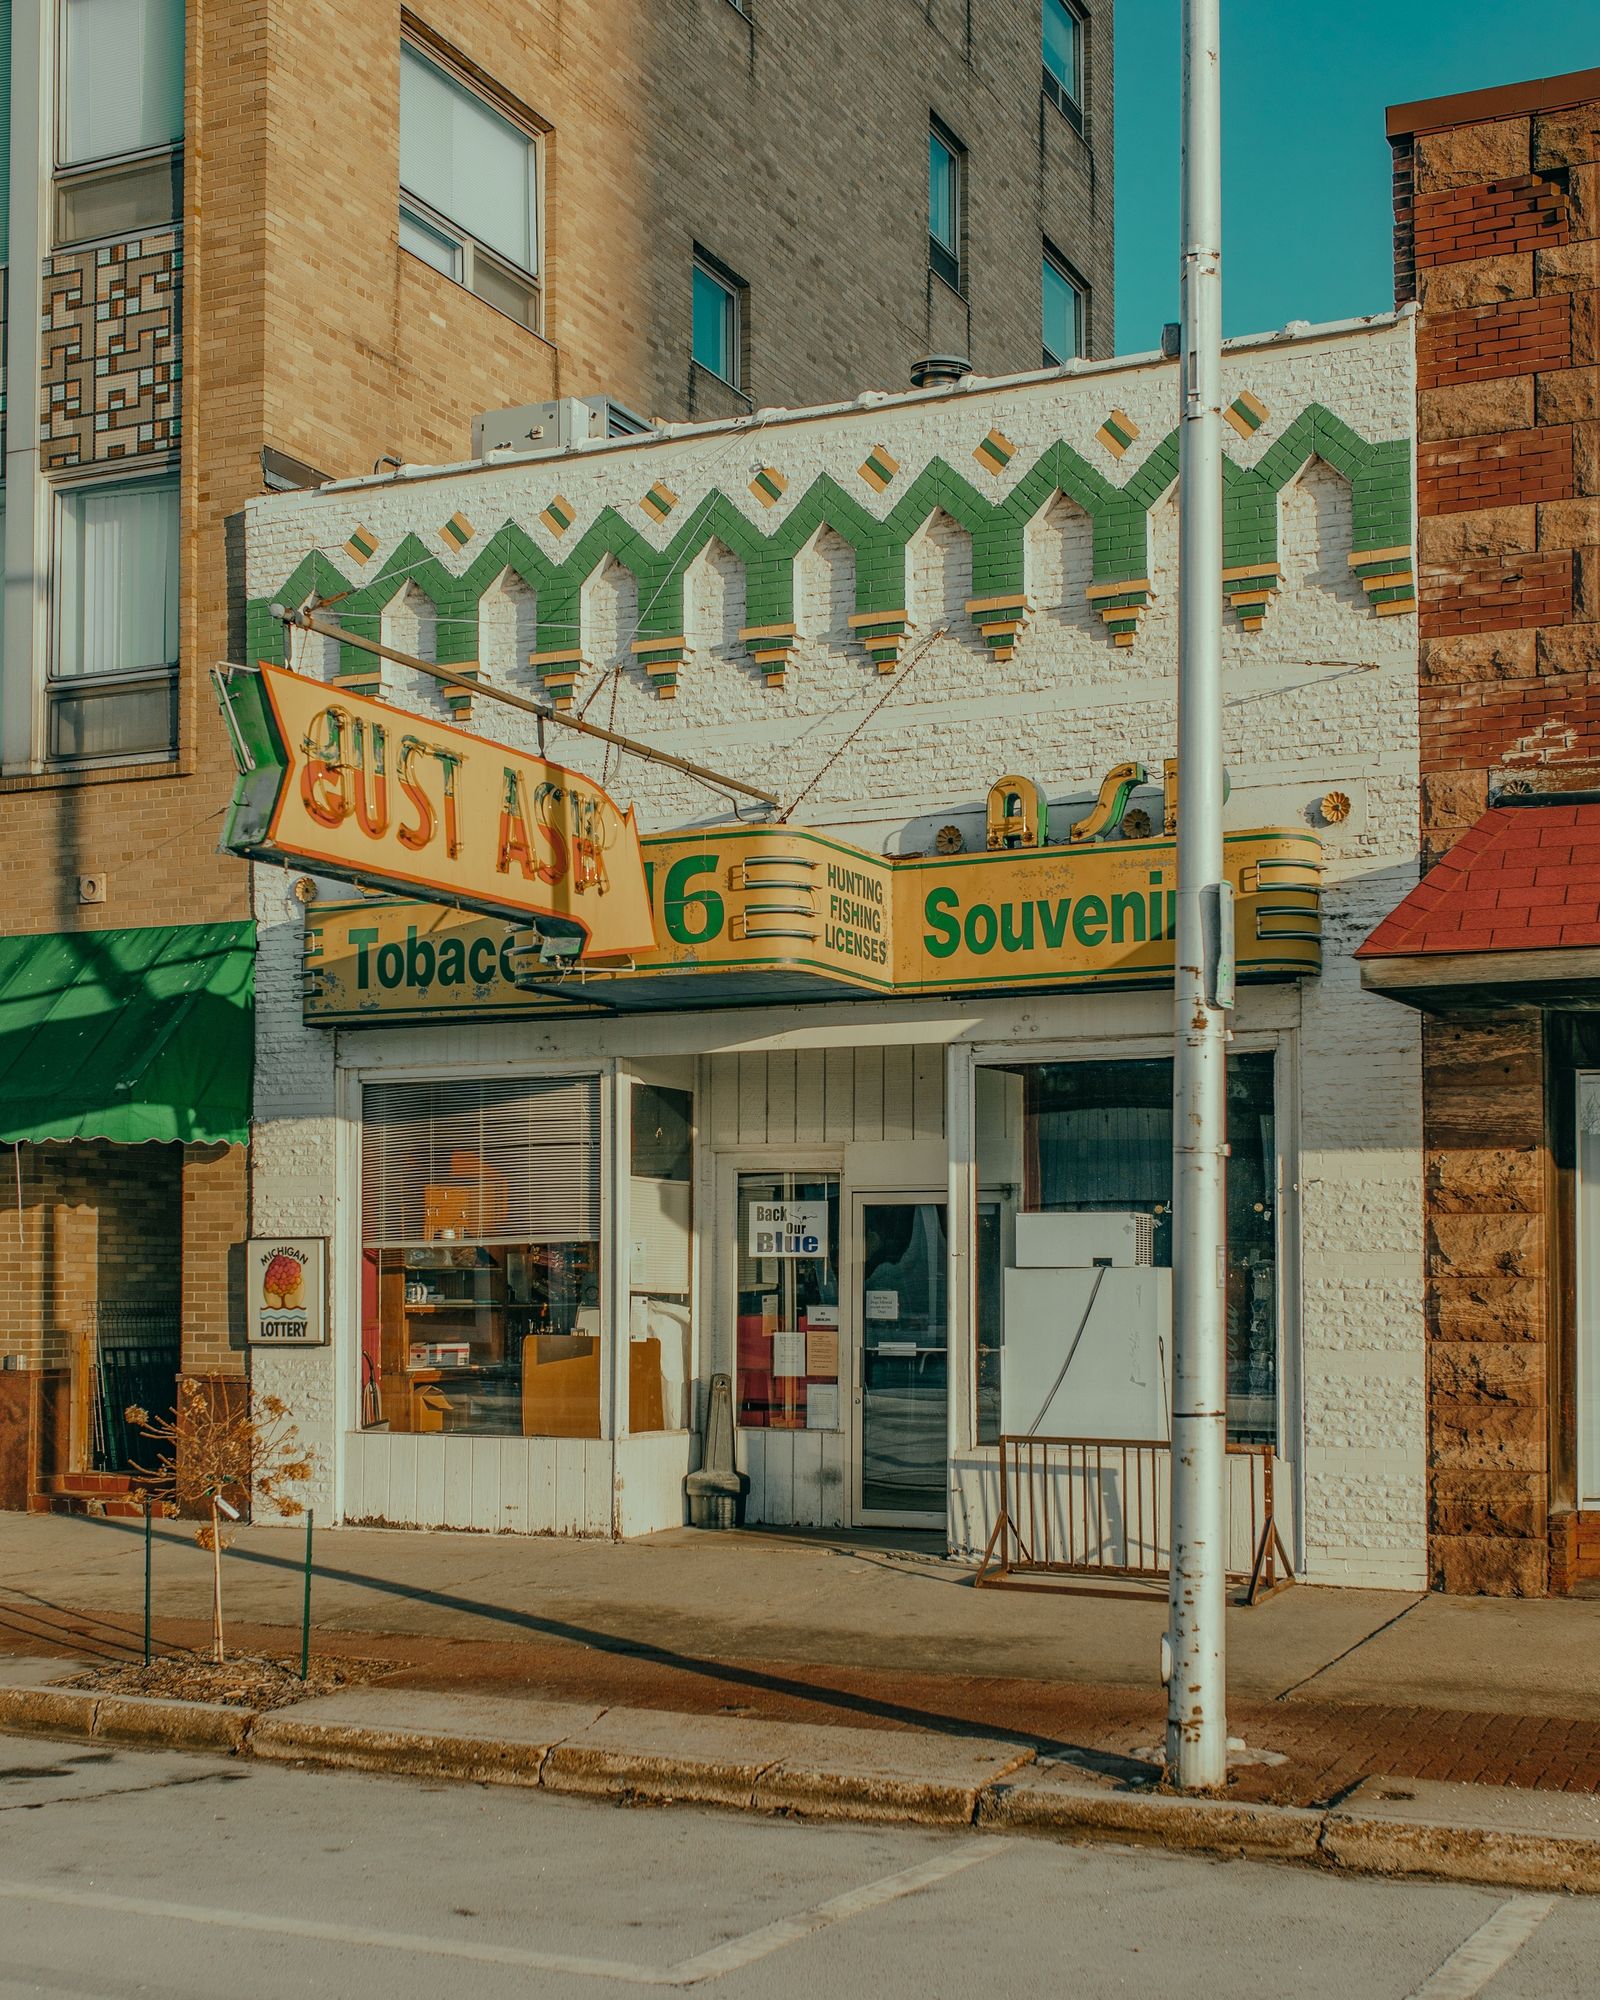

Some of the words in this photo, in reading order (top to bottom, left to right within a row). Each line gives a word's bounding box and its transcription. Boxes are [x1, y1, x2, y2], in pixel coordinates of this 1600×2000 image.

[300, 704, 470, 860] GUST
[827, 863, 883, 904] HUNTING
[644, 855, 725, 945] 6
[830, 894, 881, 933] FISHING
[825, 923, 887, 965] LICENSES
[756, 1205, 788, 1221] Back
[786, 1222, 807, 1234] Our
[260, 1246, 309, 1267] MICHIGAN
[756, 1231, 819, 1253] Blue
[260, 1321, 308, 1337] LOTTERY
